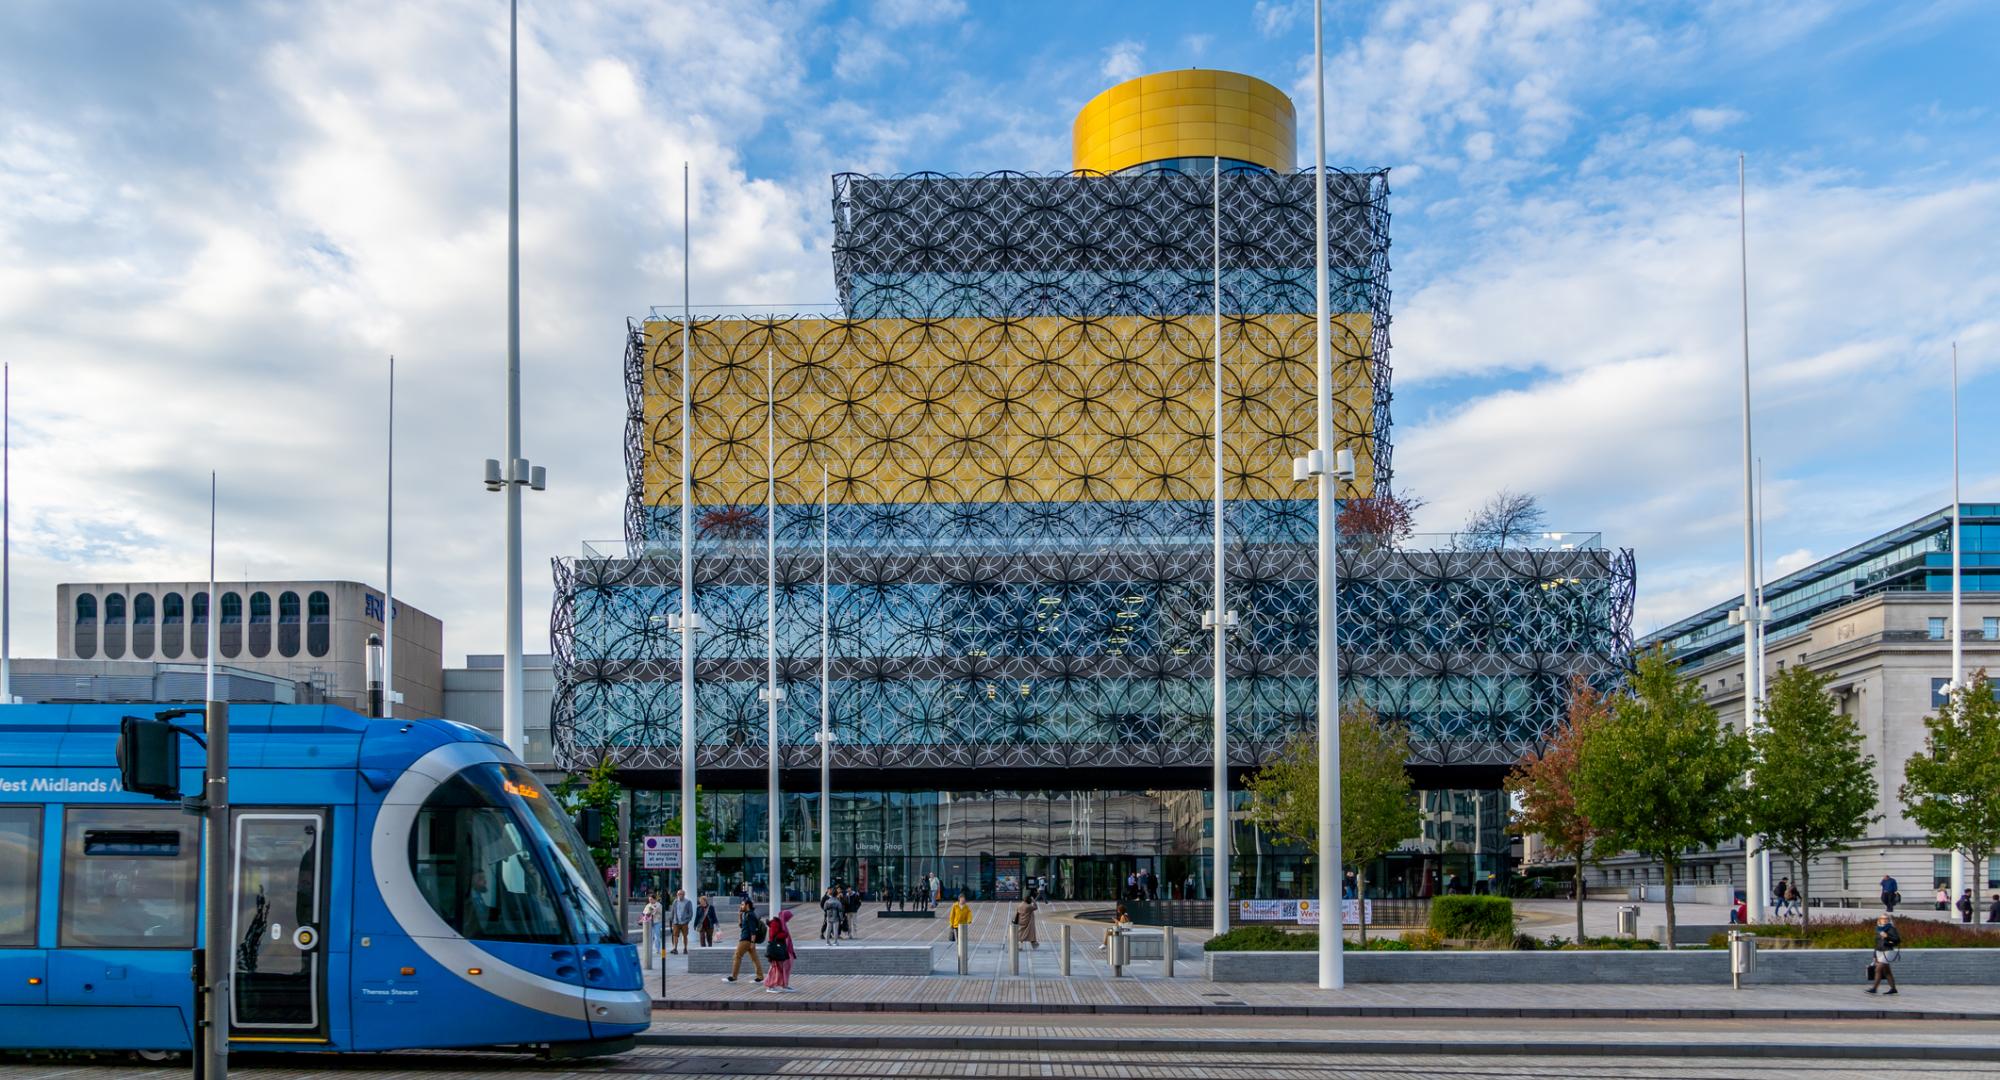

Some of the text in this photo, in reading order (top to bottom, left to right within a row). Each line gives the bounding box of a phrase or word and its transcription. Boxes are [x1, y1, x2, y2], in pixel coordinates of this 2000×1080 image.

[0, 778, 27, 792] est
[30, 778, 107, 792] Midlands
[855, 842, 903, 851] Library Shop
